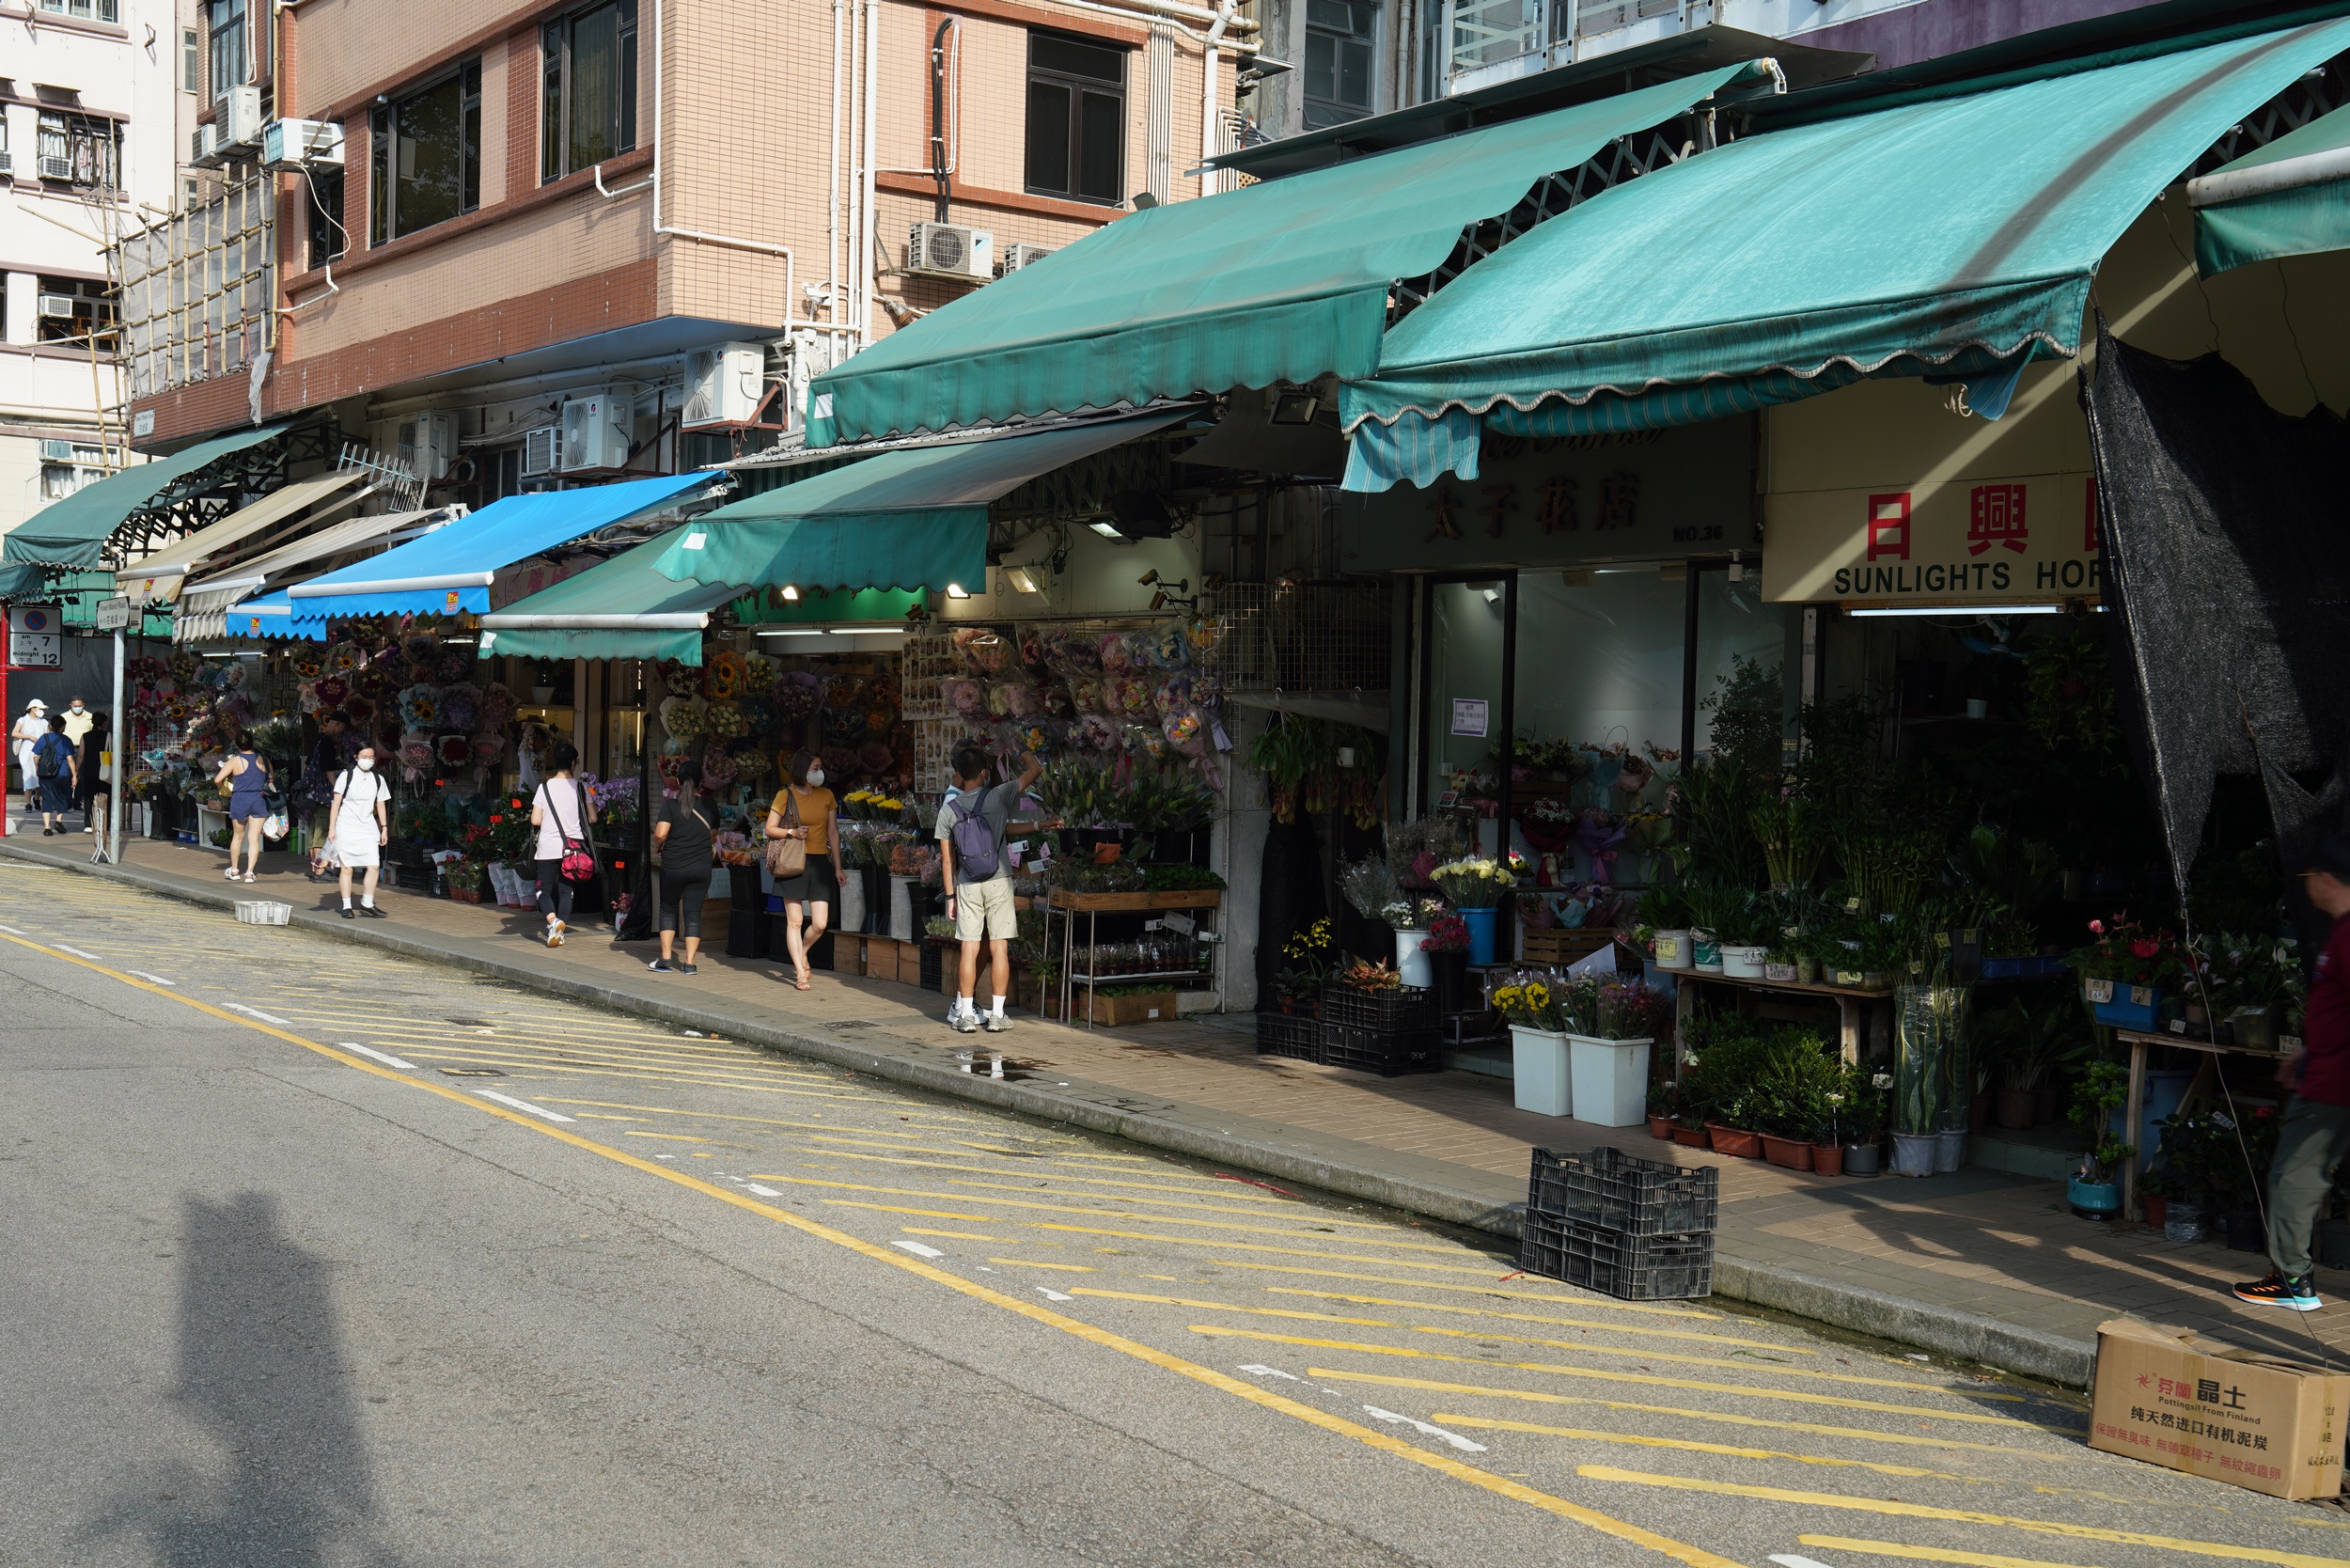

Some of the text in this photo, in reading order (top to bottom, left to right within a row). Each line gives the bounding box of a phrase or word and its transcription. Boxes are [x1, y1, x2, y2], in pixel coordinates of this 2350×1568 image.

[1423, 470, 1640, 543] 太子花店
[1867, 477, 2100, 561] 日興
[1672, 524, 1723, 543] NO.36
[1834, 561, 2011, 594] SUNLIGHTS
[41, 635, 51, 647] 7
[42, 652, 57, 665] 12
[2196, 1378, 2247, 1411] 晶土
[2130, 1404, 2268, 1451] 纯天然进口有机泥炭
[2201, 1405, 2224, 1418] From
[2226, 1410, 2262, 1425] Finland
